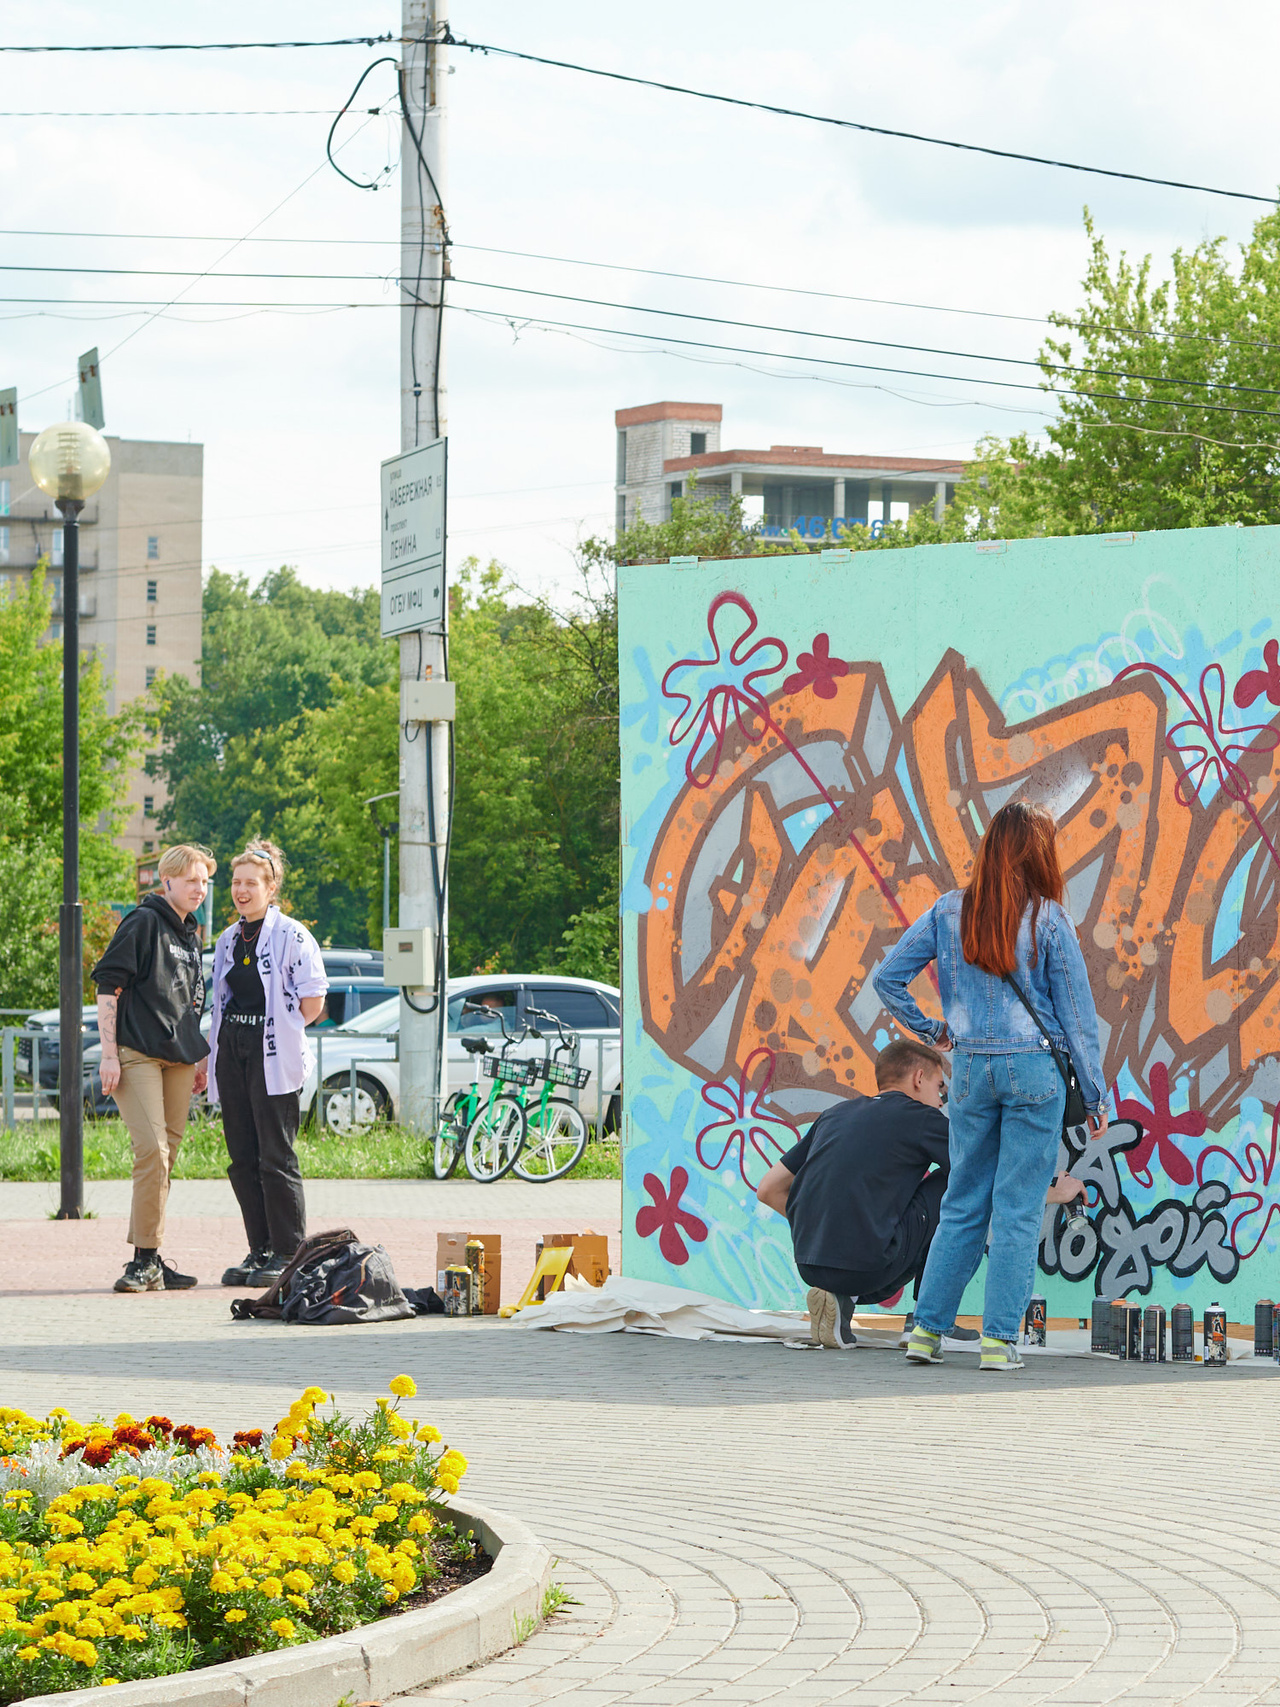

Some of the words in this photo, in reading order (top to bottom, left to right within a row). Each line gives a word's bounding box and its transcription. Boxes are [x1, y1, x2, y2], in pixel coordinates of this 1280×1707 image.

[389, 475, 433, 508] НАБЕРЕЖНАЯ
[389, 533, 417, 561] ЛЕНИНА
[407, 587, 423, 611] МФЦ
